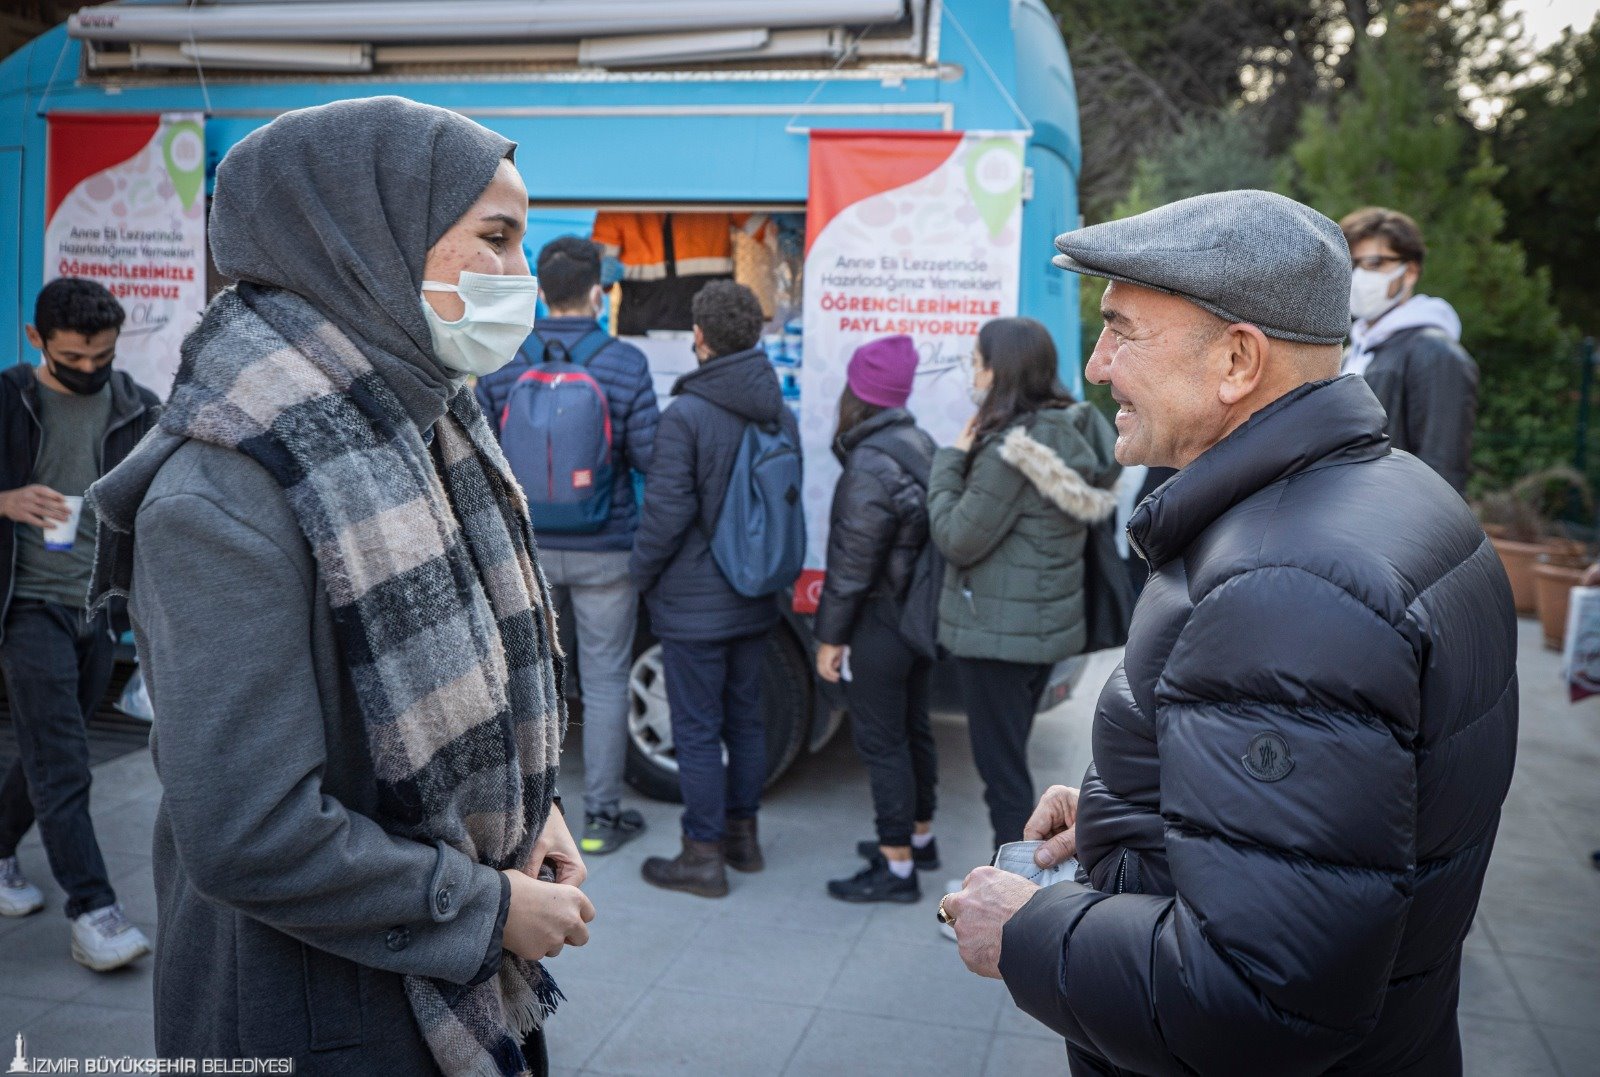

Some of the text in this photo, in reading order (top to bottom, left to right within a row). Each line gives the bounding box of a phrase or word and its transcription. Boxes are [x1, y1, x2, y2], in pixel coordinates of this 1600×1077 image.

[70, 226, 100, 239] Anne
[120, 226, 183, 242] Lezzetinde
[59, 258, 194, 280] ÖĞRENCİLERİMİZLE
[836, 256, 988, 272] Anne Eli Lezzetinde
[109, 284, 179, 298] AŞIYORUZ
[821, 273, 1002, 292] Hazırladığımız Yemekleri
[820, 291, 1000, 316] ÖĞRENCİLERİMİZLE
[839, 317, 979, 336] PAYLAŞIYORUZ
